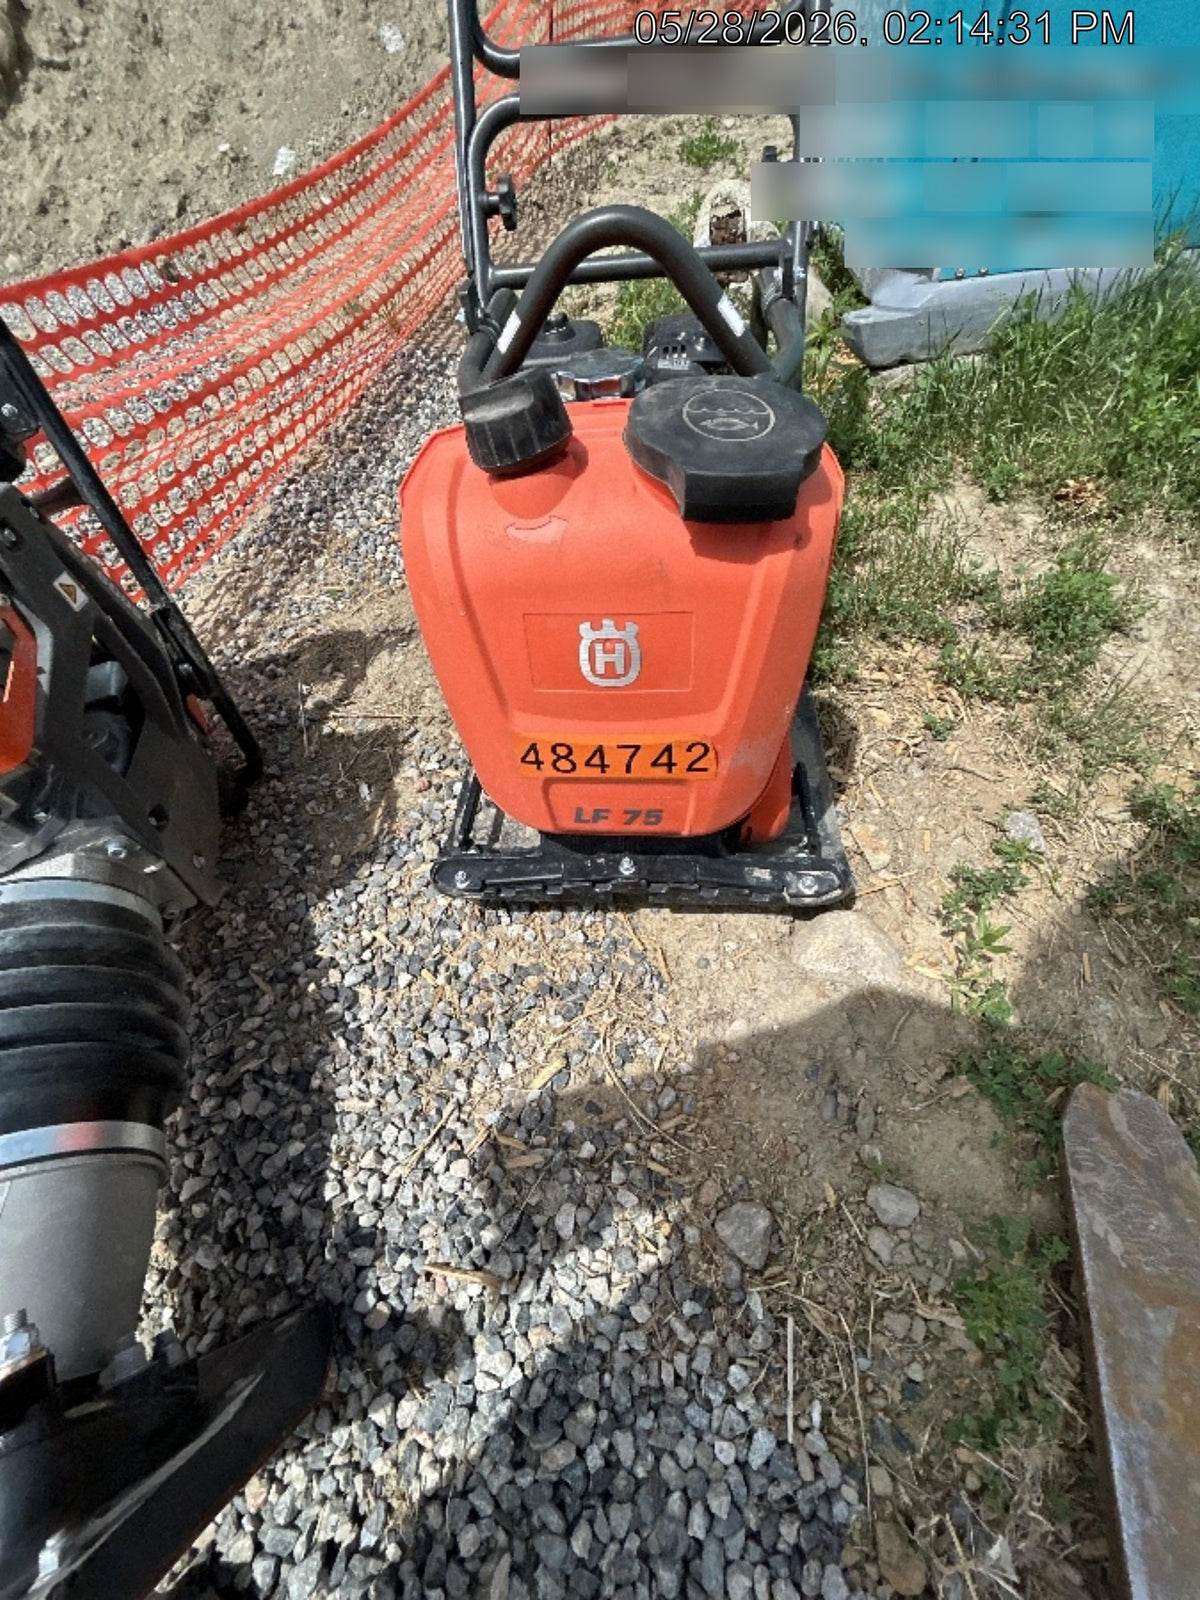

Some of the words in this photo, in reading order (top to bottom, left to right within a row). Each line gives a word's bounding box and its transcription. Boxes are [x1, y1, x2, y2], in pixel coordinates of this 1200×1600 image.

[520, 742, 711, 774] 484742
[574, 807, 610, 824] LF
[623, 809, 663, 826] 75
